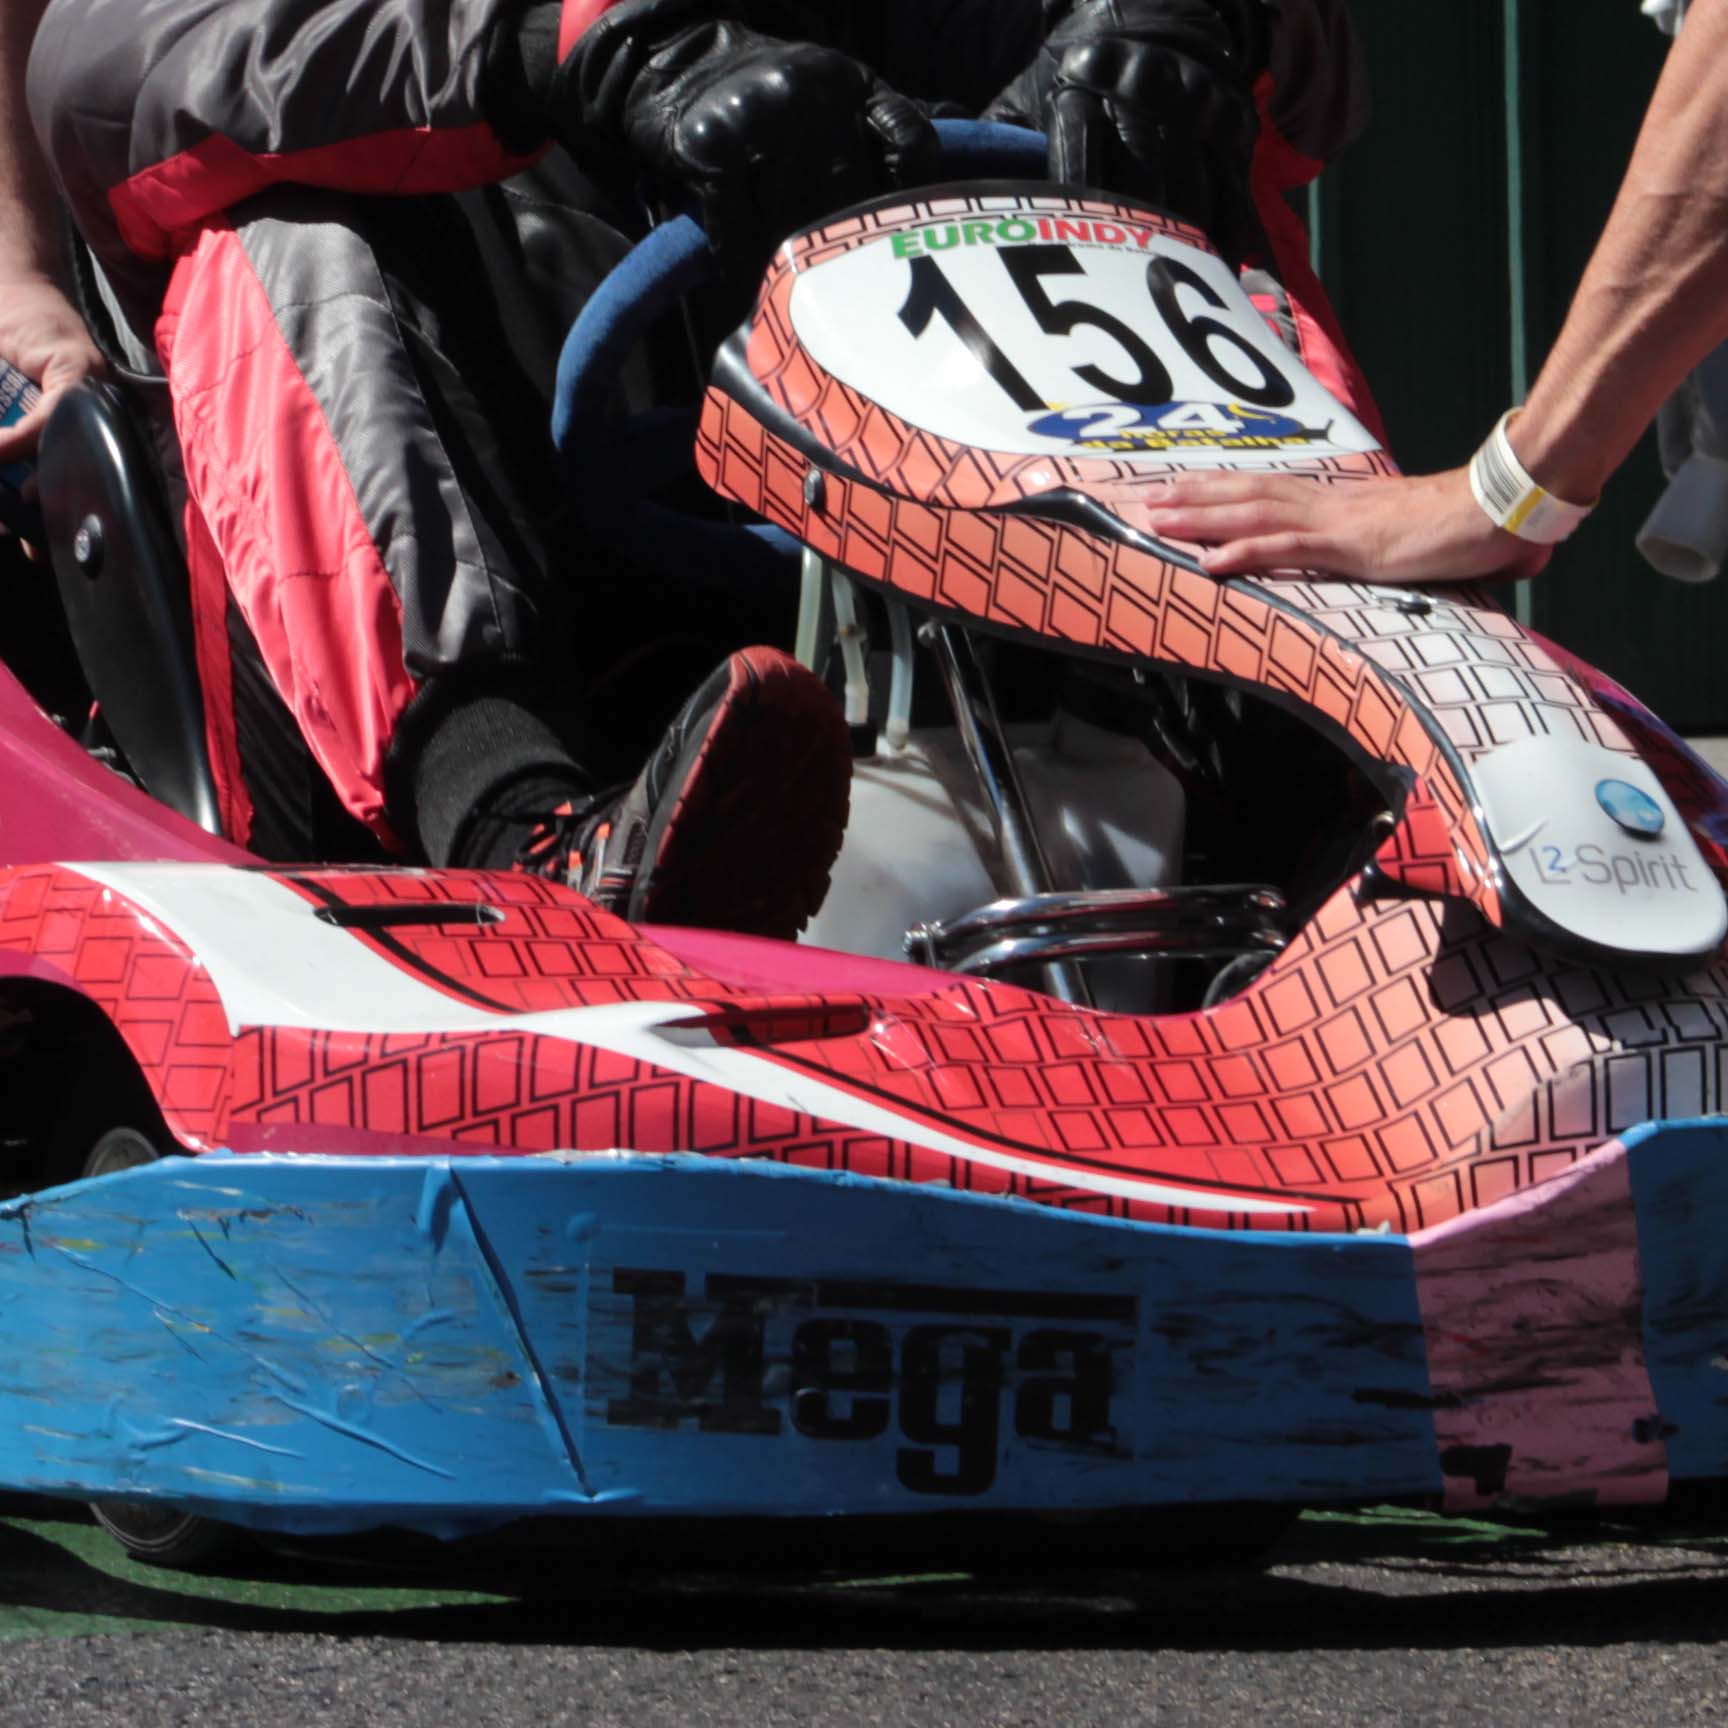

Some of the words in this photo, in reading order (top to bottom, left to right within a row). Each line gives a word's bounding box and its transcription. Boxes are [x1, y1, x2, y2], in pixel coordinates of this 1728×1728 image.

[889, 216, 1157, 259] EUROINDY
[896, 243, 1297, 414] 156
[1062, 402, 1247, 439] 24
[605, 1269, 1141, 1496] Mega
